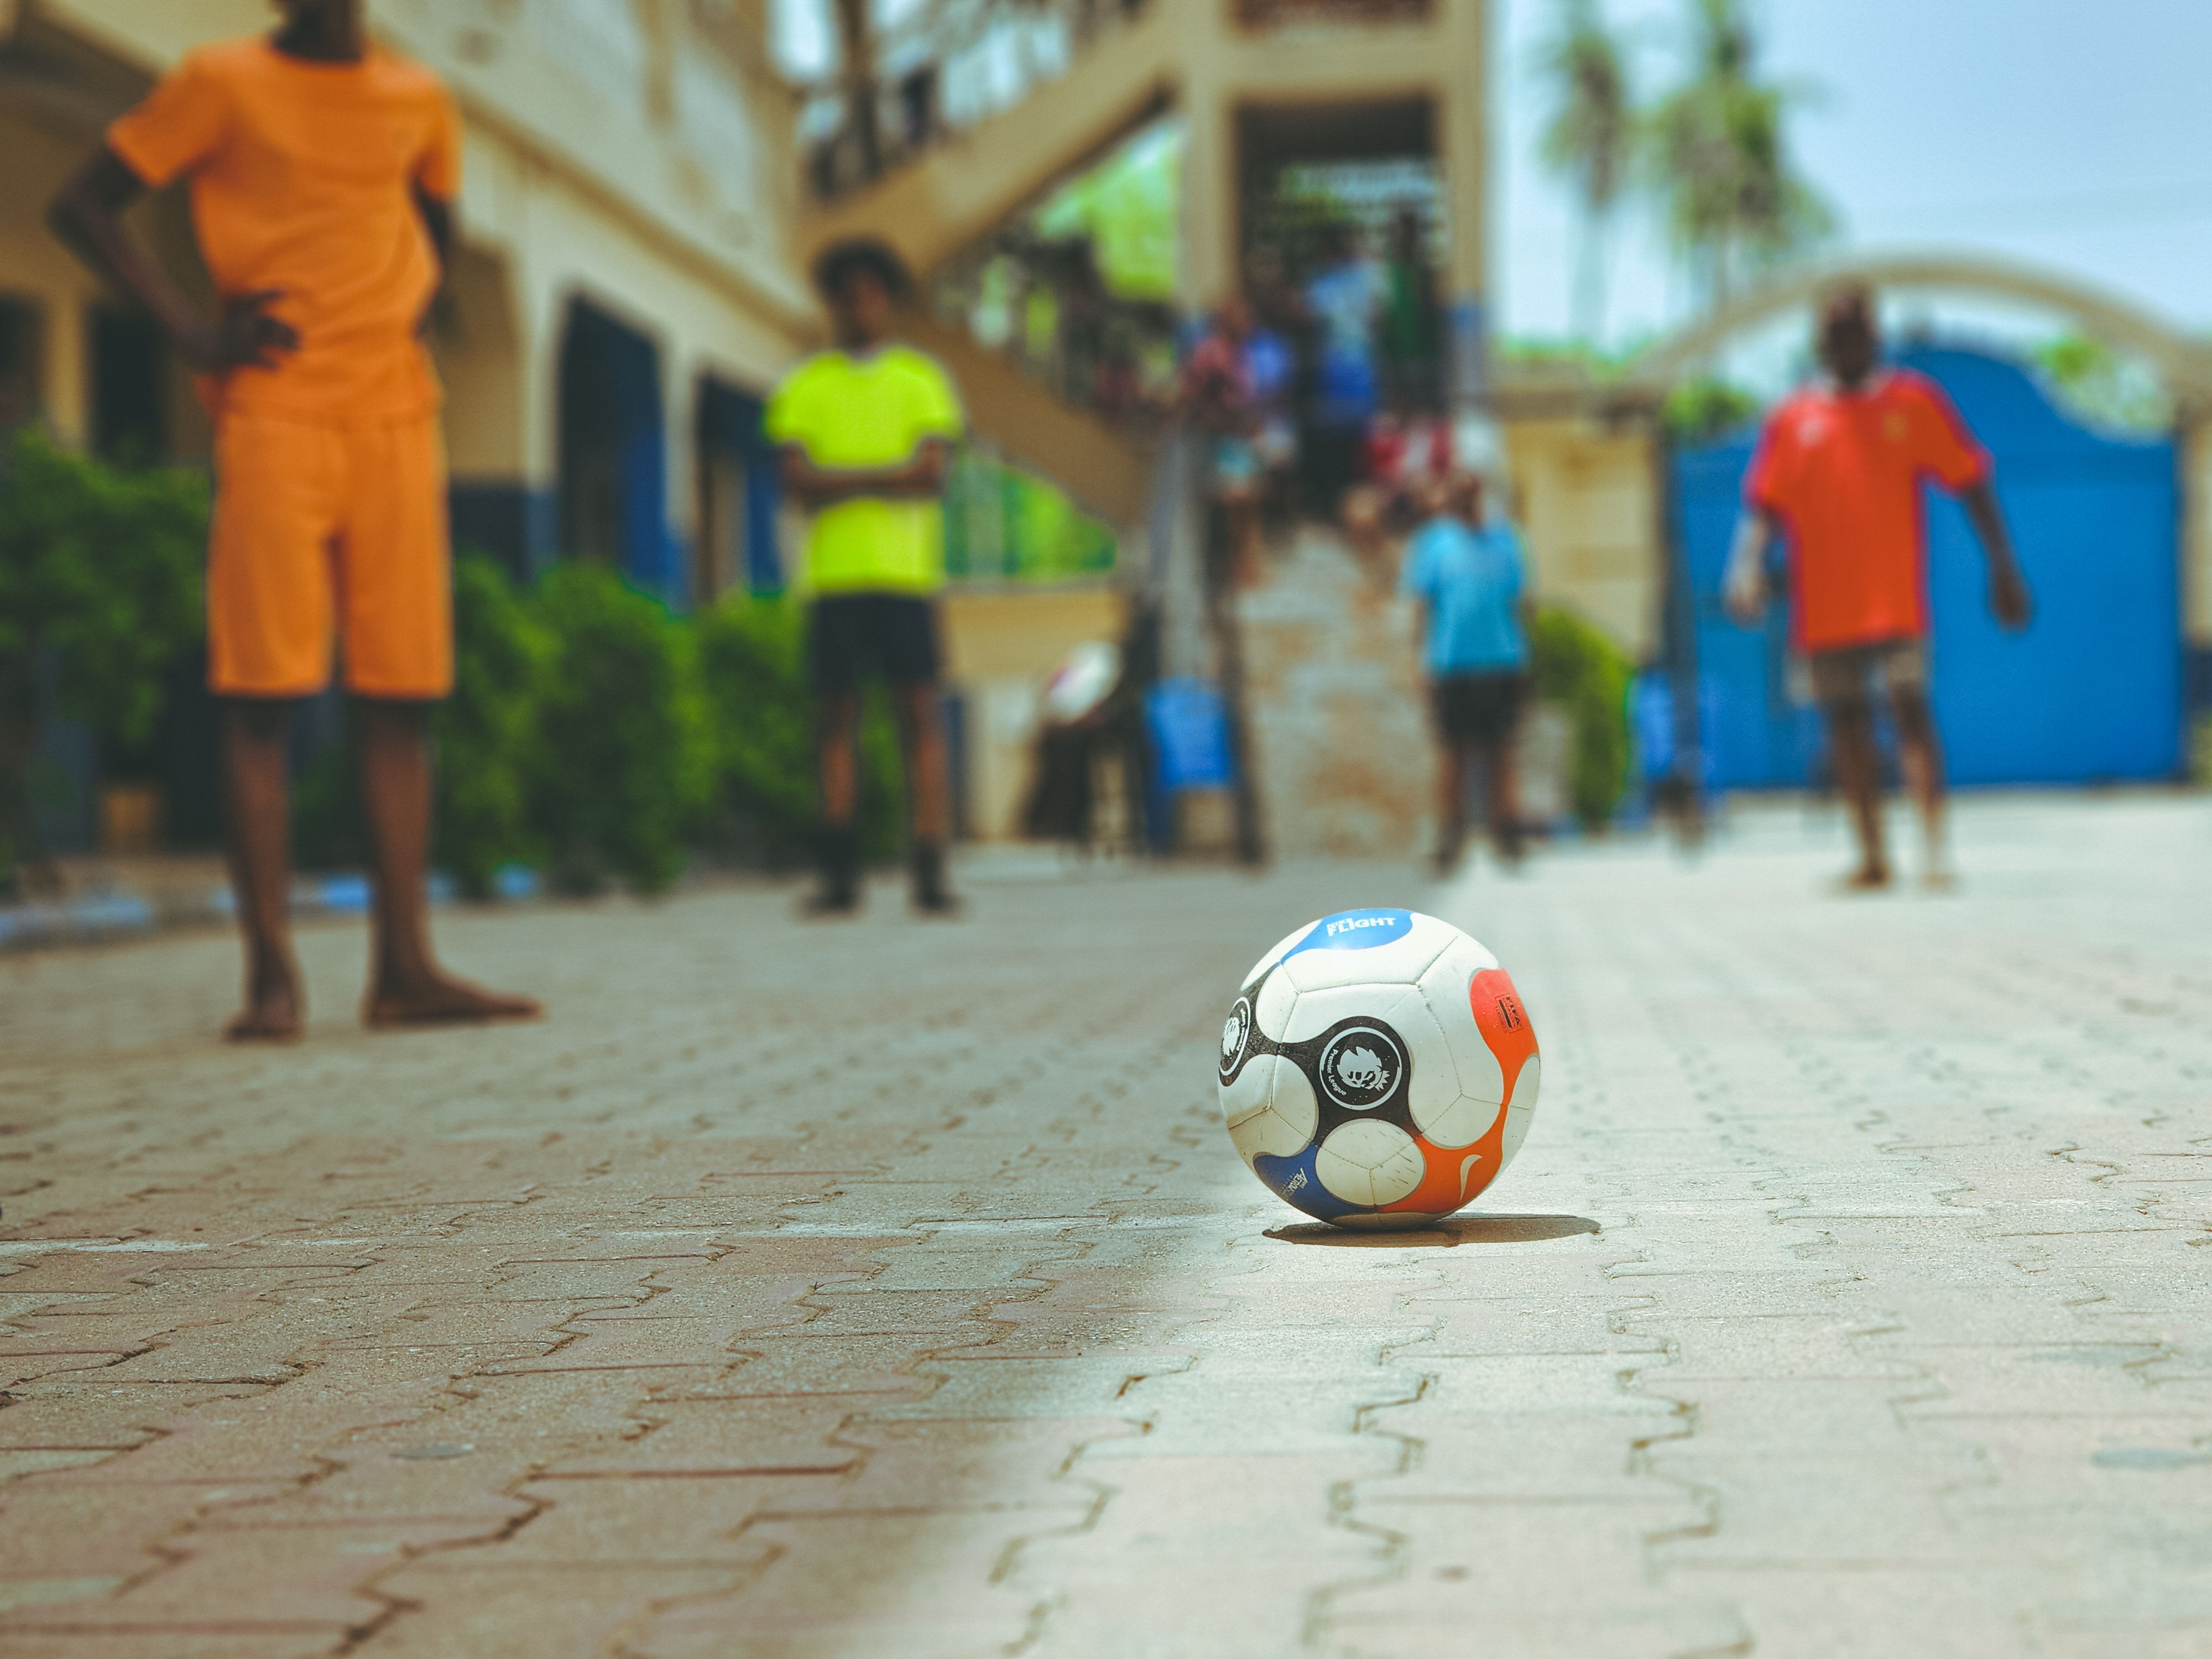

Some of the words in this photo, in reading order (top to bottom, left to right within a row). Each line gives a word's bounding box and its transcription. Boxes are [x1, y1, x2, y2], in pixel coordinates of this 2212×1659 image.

[1327, 917, 1396, 937] FLIGHT
[1326, 1048, 1339, 1074] Premier
[1328, 1074, 1347, 1096] League
